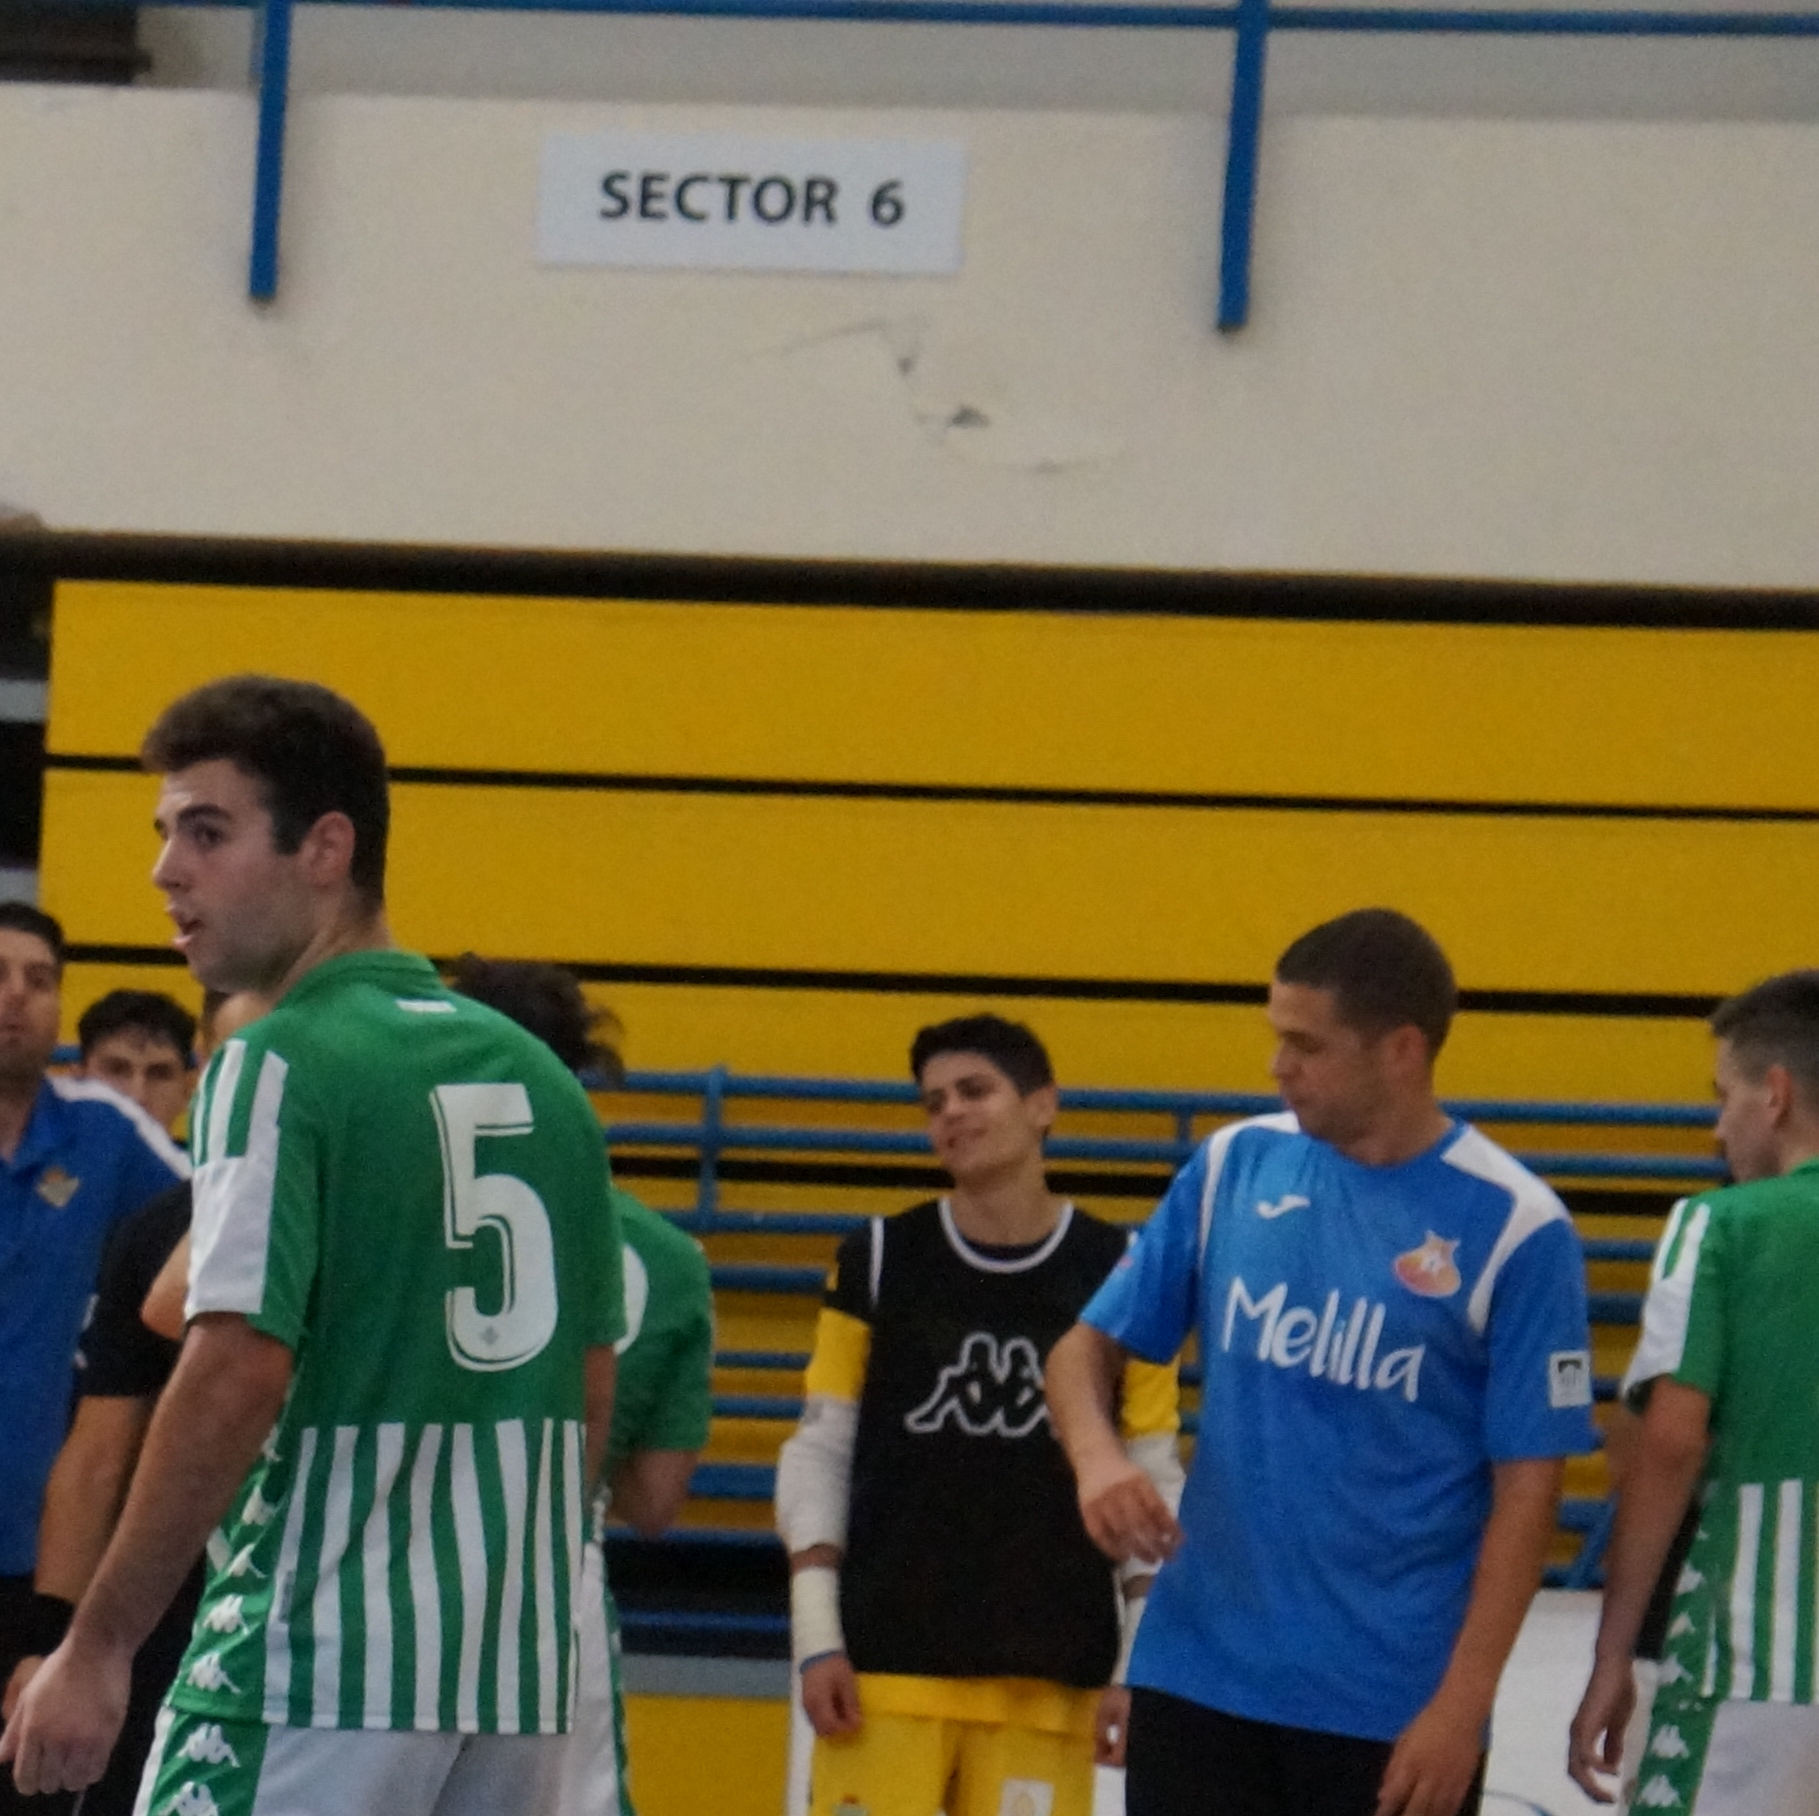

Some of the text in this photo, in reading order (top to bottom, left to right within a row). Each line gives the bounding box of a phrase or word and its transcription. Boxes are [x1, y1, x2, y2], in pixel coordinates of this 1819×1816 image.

[599, 170, 907, 227] SECTOR 6
[429, 1082, 559, 1372] 5
[1222, 1275, 1427, 1402] Melilla
